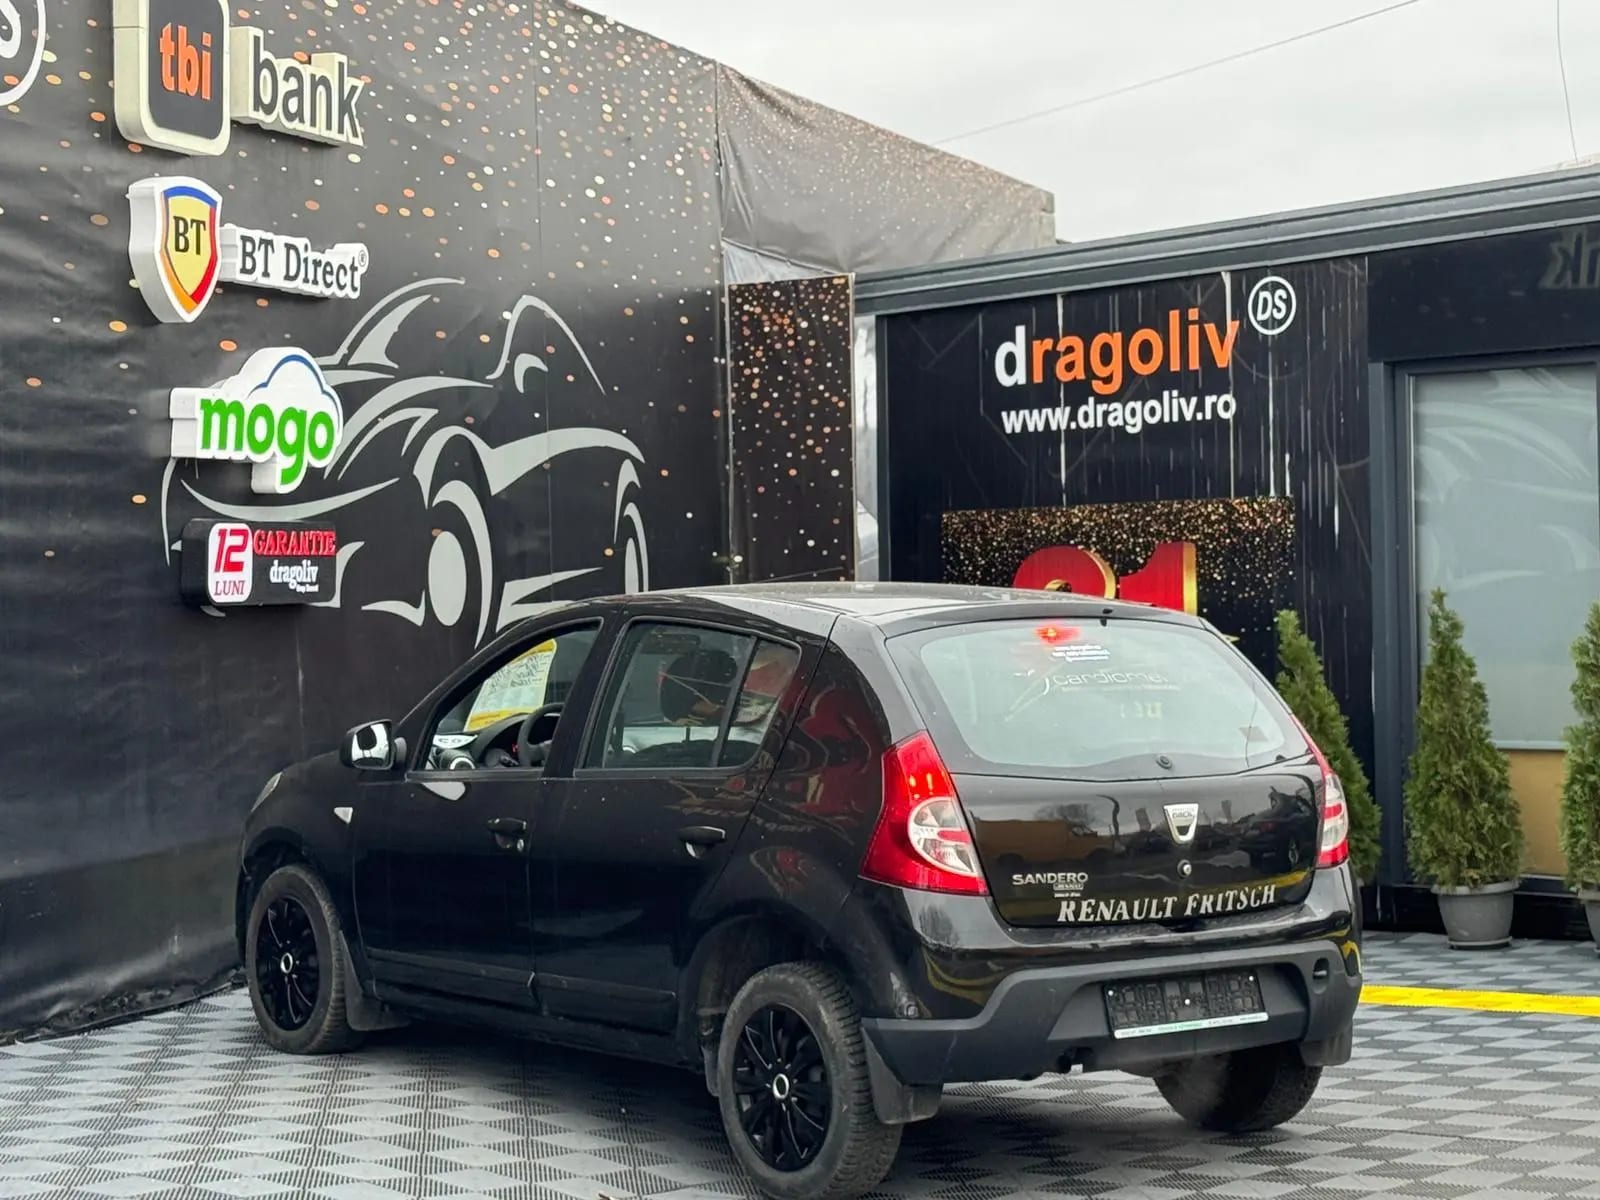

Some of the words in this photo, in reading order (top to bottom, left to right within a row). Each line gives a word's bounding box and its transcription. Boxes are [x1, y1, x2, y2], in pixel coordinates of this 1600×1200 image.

[160, 22, 212, 101] tbi
[252, 34, 361, 140] bank
[173, 215, 206, 256] BT
[239, 234, 275, 278] BT
[1255, 290, 1287, 321] DS
[994, 307, 1240, 396] dragoliv
[1001, 389, 1237, 434] www.dragoliv.ro
[200, 398, 335, 486] mogo
[213, 528, 249, 573] 12
[252, 529, 337, 557] GARANTIE
[213, 580, 247, 596] LUNI
[269, 559, 319, 590] dragoliv
[1011, 871, 1089, 886] SANDERO
[1057, 896, 1178, 923] RENAULT
[1183, 884, 1277, 917] FRITSCH
